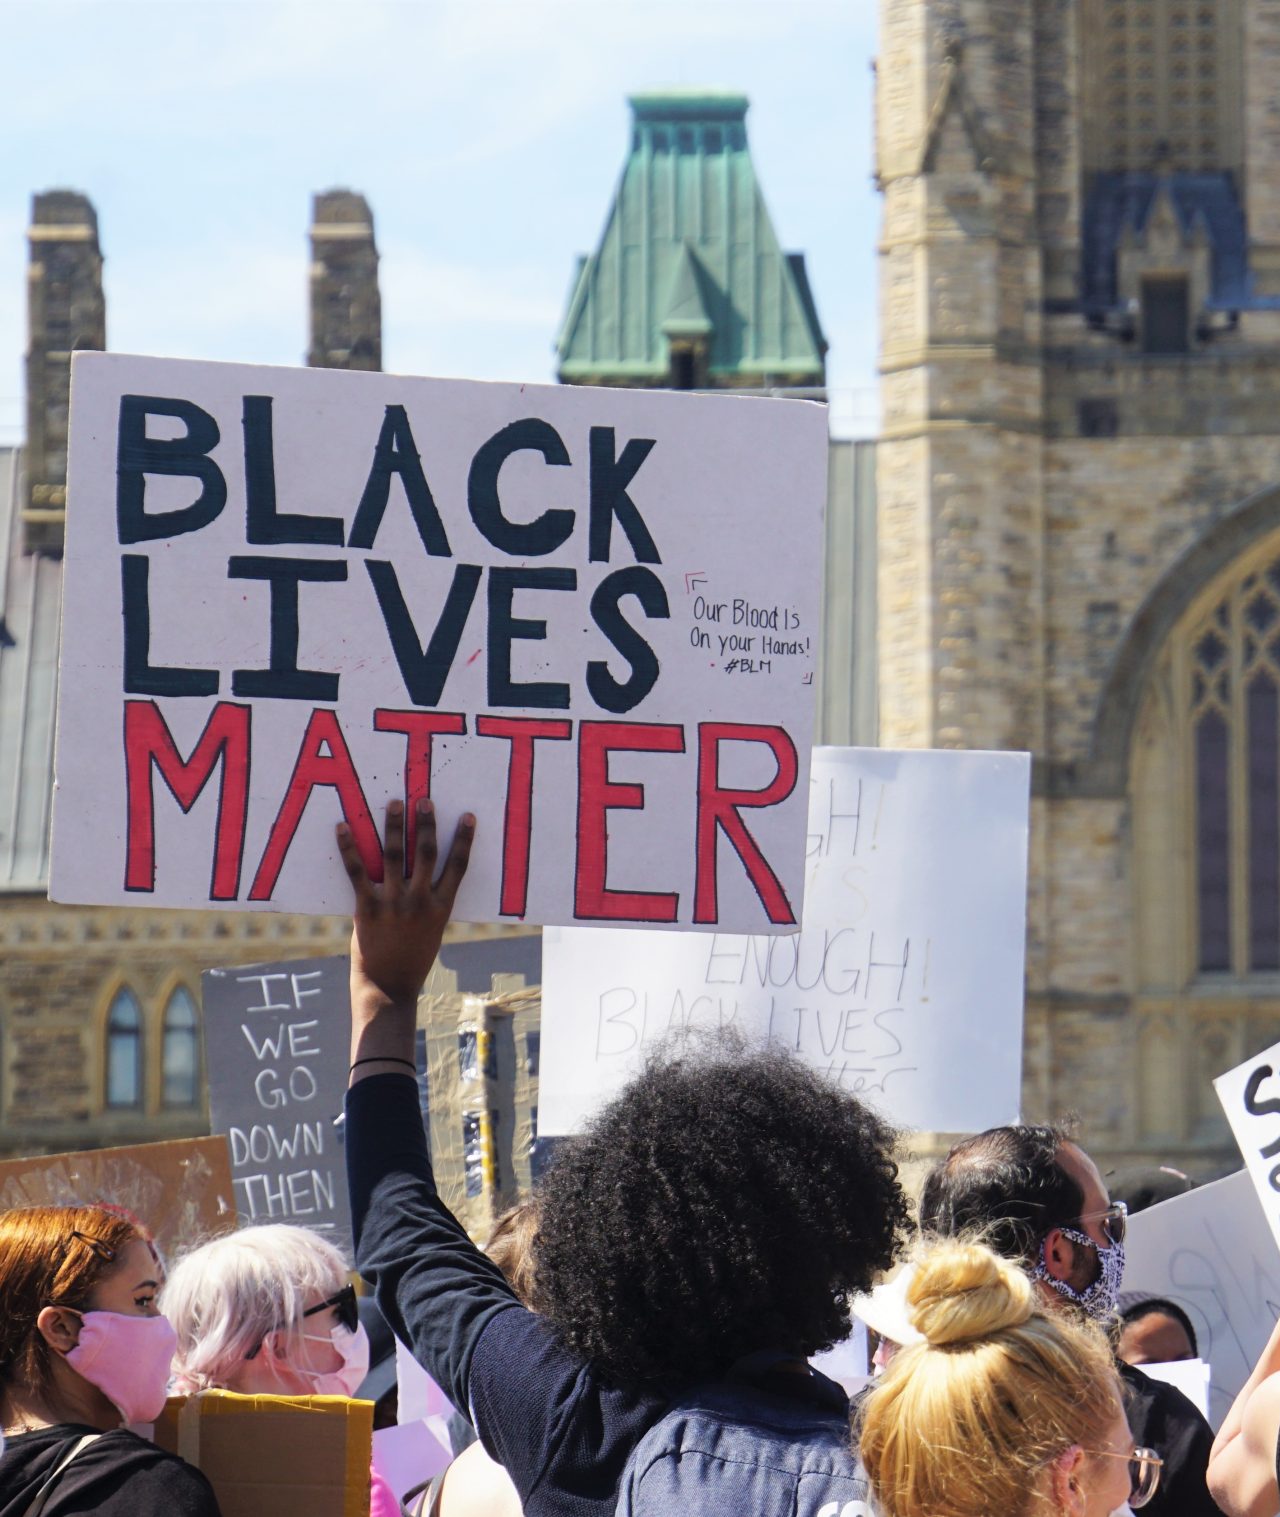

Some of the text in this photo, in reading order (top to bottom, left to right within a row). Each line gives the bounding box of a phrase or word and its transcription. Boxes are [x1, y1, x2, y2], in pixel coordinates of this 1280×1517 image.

[116, 394, 663, 564] BLACK
[120, 554, 671, 714] LIVES
[693, 596, 728, 623] Our
[733, 599, 778, 631] Blood
[690, 627, 810, 658] On your Hands!
[724, 658, 771, 674] #BLM
[123, 699, 799, 926] MATTER
[236, 971, 323, 1012] IF
[241, 1019, 320, 1060] WE
[254, 1065, 317, 1110] GO
[229, 1121, 323, 1167] DOWN
[232, 1169, 334, 1219] THEN
